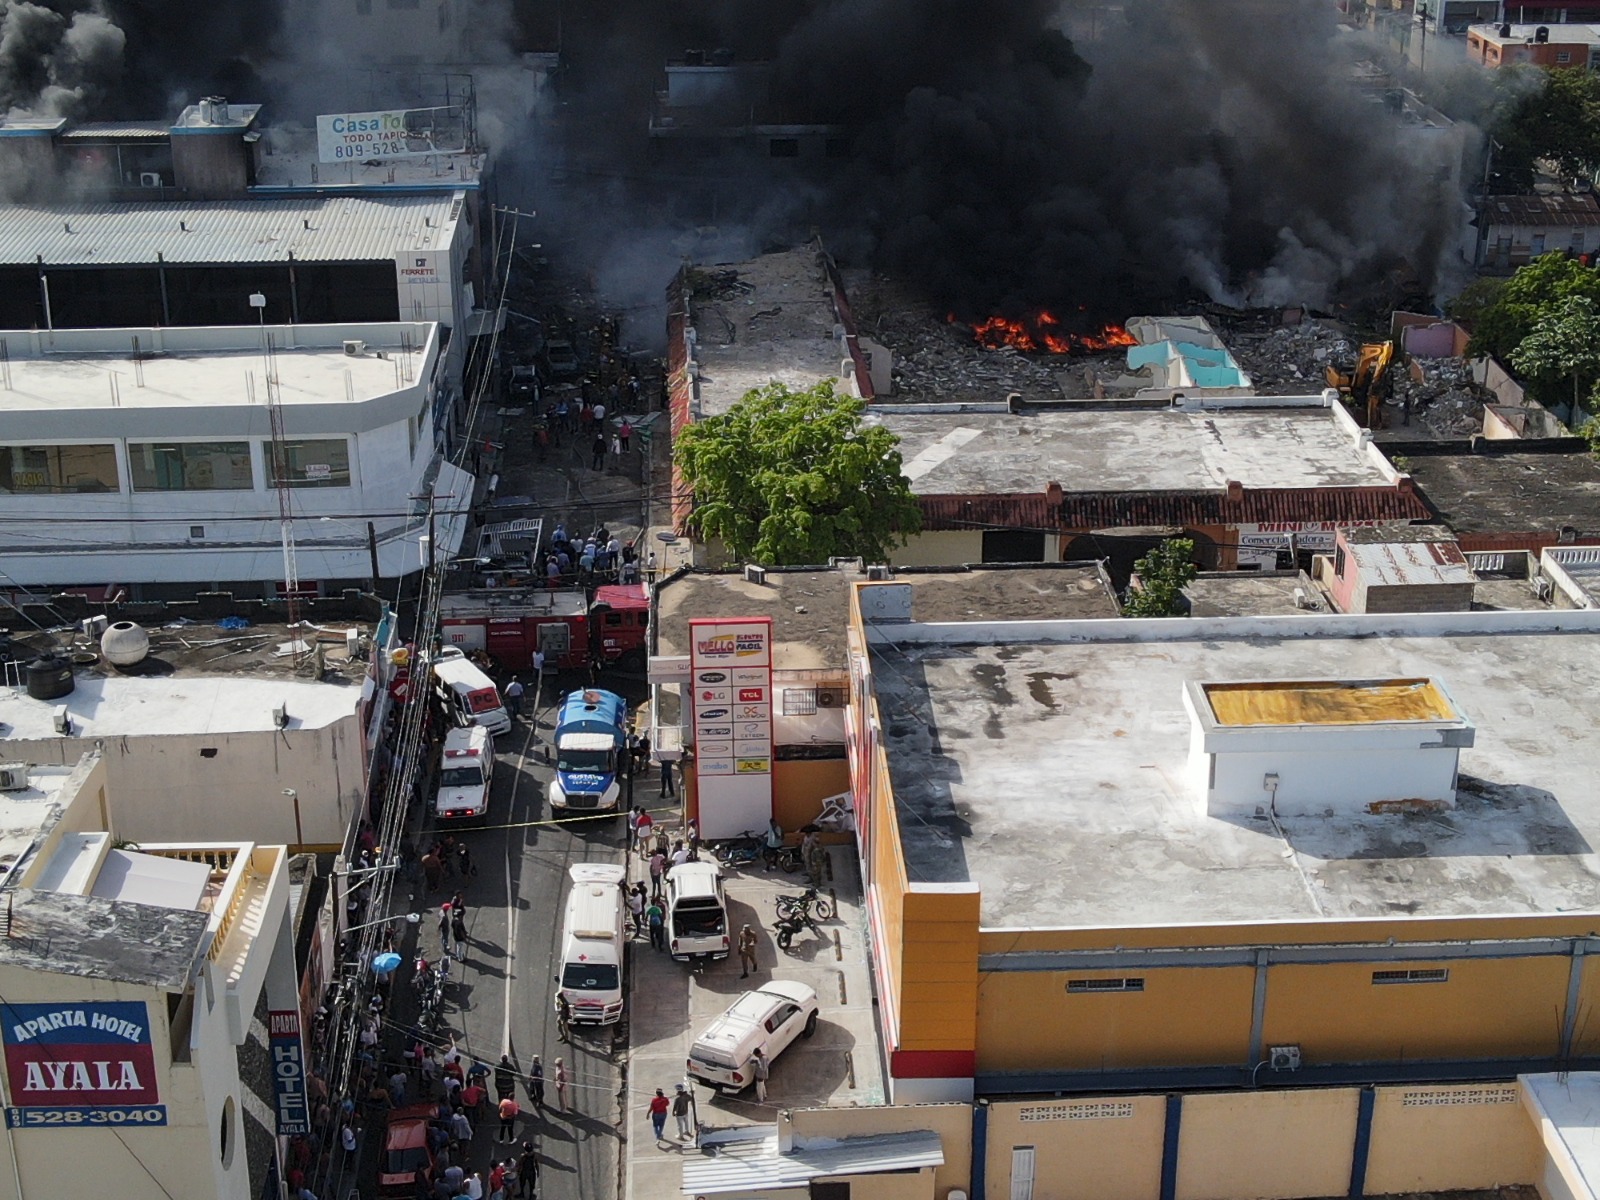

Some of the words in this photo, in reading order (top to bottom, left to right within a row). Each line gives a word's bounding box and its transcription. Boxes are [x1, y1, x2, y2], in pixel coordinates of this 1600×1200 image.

[332, 117, 379, 133] Casa
[343, 133, 373, 143] TODO
[1258, 523, 1302, 532] MINI
[742, 691, 760, 699] TCL
[13, 1010, 87, 1042] APARTA
[91, 1012, 143, 1043] HOTEL
[271, 1015, 298, 1034] APARTA
[22, 1061, 144, 1092] AYALA
[274, 1045, 304, 1123] HOTEL
[26, 1109, 163, 1124] 528-3040
[279, 1124, 306, 1133] AYALA
